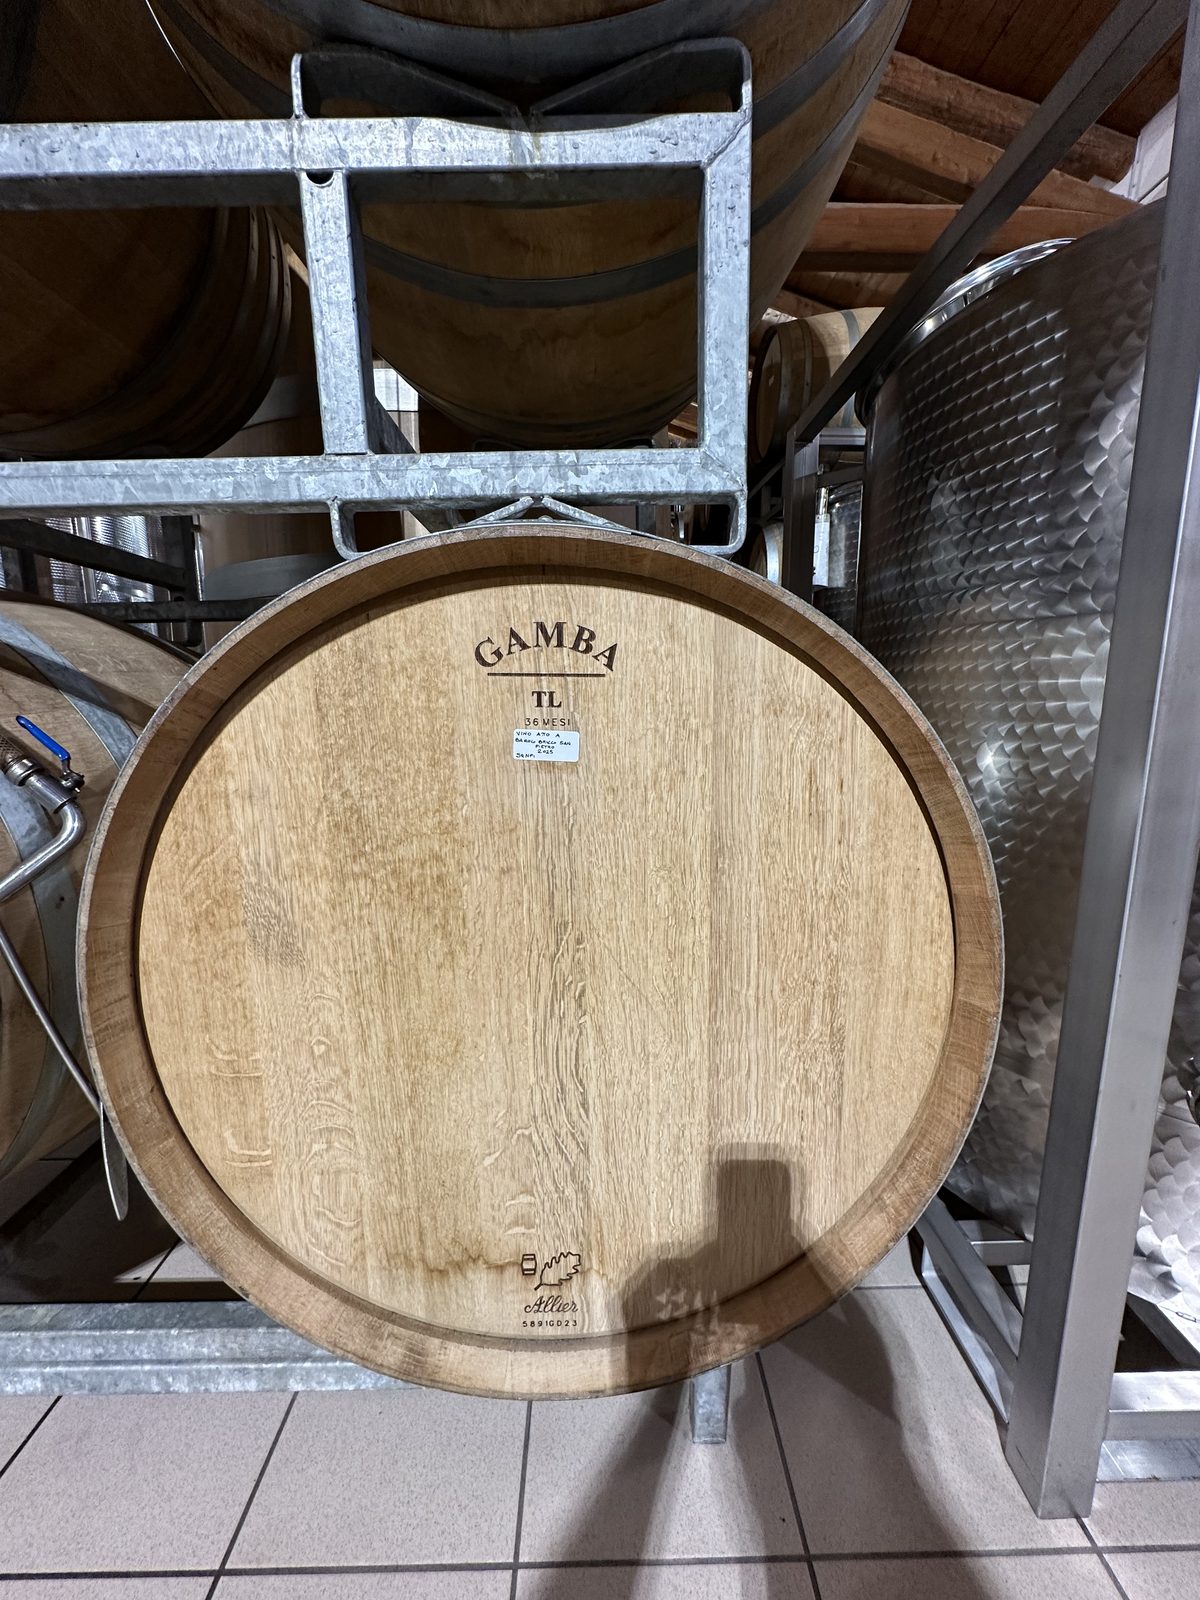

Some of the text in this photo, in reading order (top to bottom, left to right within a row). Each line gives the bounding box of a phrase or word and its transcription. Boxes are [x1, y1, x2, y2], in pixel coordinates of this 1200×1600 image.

[474, 621, 618, 672] GAMBA
[531, 690, 562, 708] TL
[525, 718, 570, 727] 36 MESI
[524, 1295, 579, 1314] Allier
